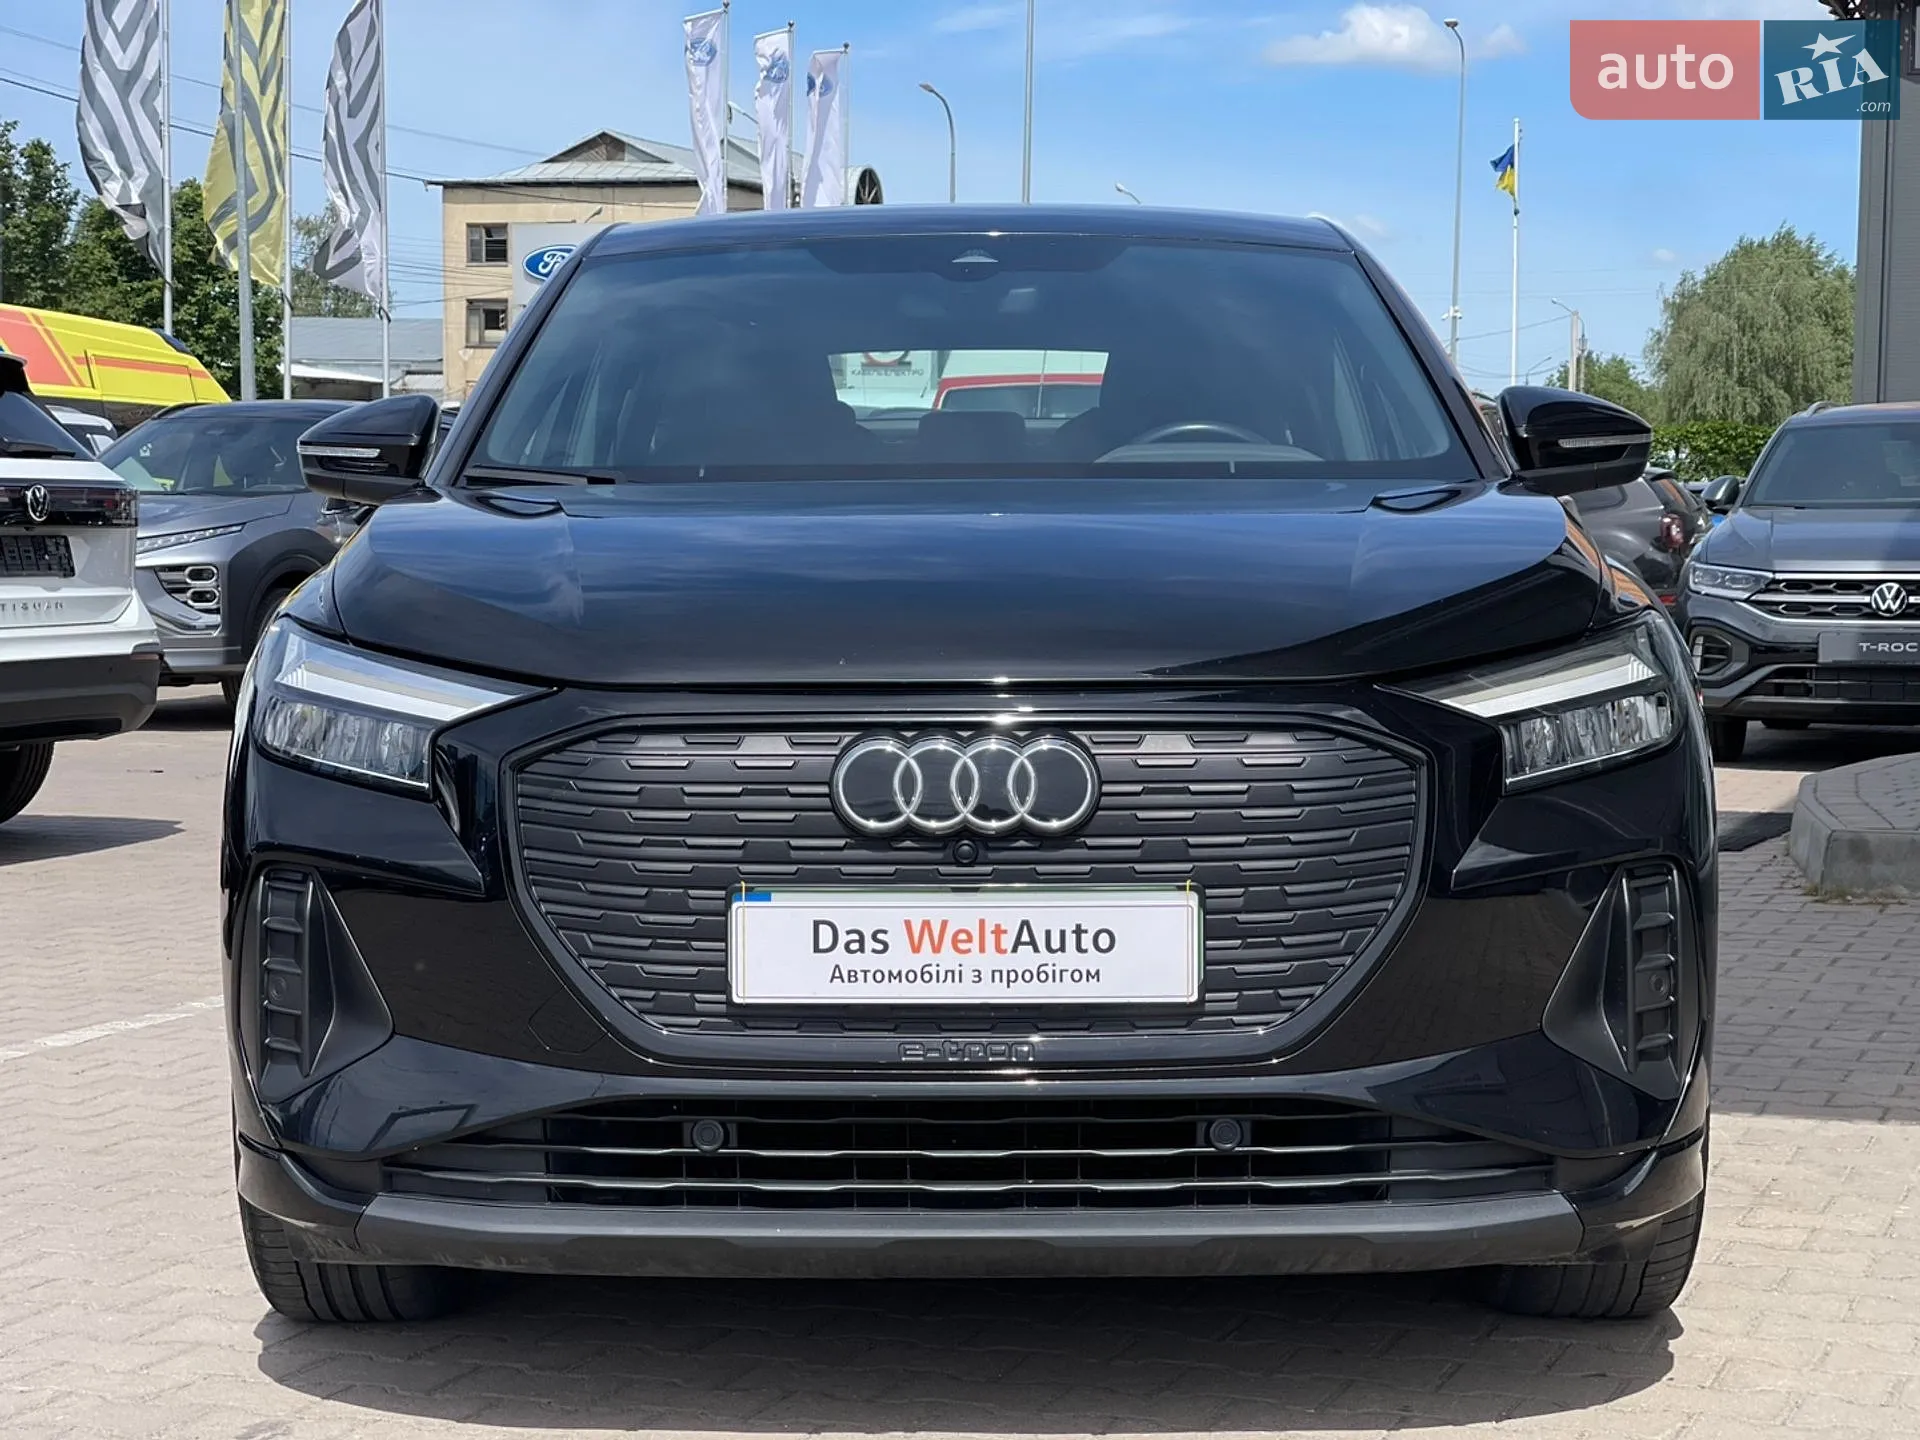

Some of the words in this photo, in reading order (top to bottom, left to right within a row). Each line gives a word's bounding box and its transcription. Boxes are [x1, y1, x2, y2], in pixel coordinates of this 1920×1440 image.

[1859, 642, 1919, 652] T-ROC
[812, 919, 890, 954] Das
[903, 918, 1117, 954] WeltAuto
[829, 963, 963, 984] Автомобілі
[971, 969, 982, 984] з
[991, 963, 1100, 988] пробігом
[898, 1040, 1035, 1061] e-tron
